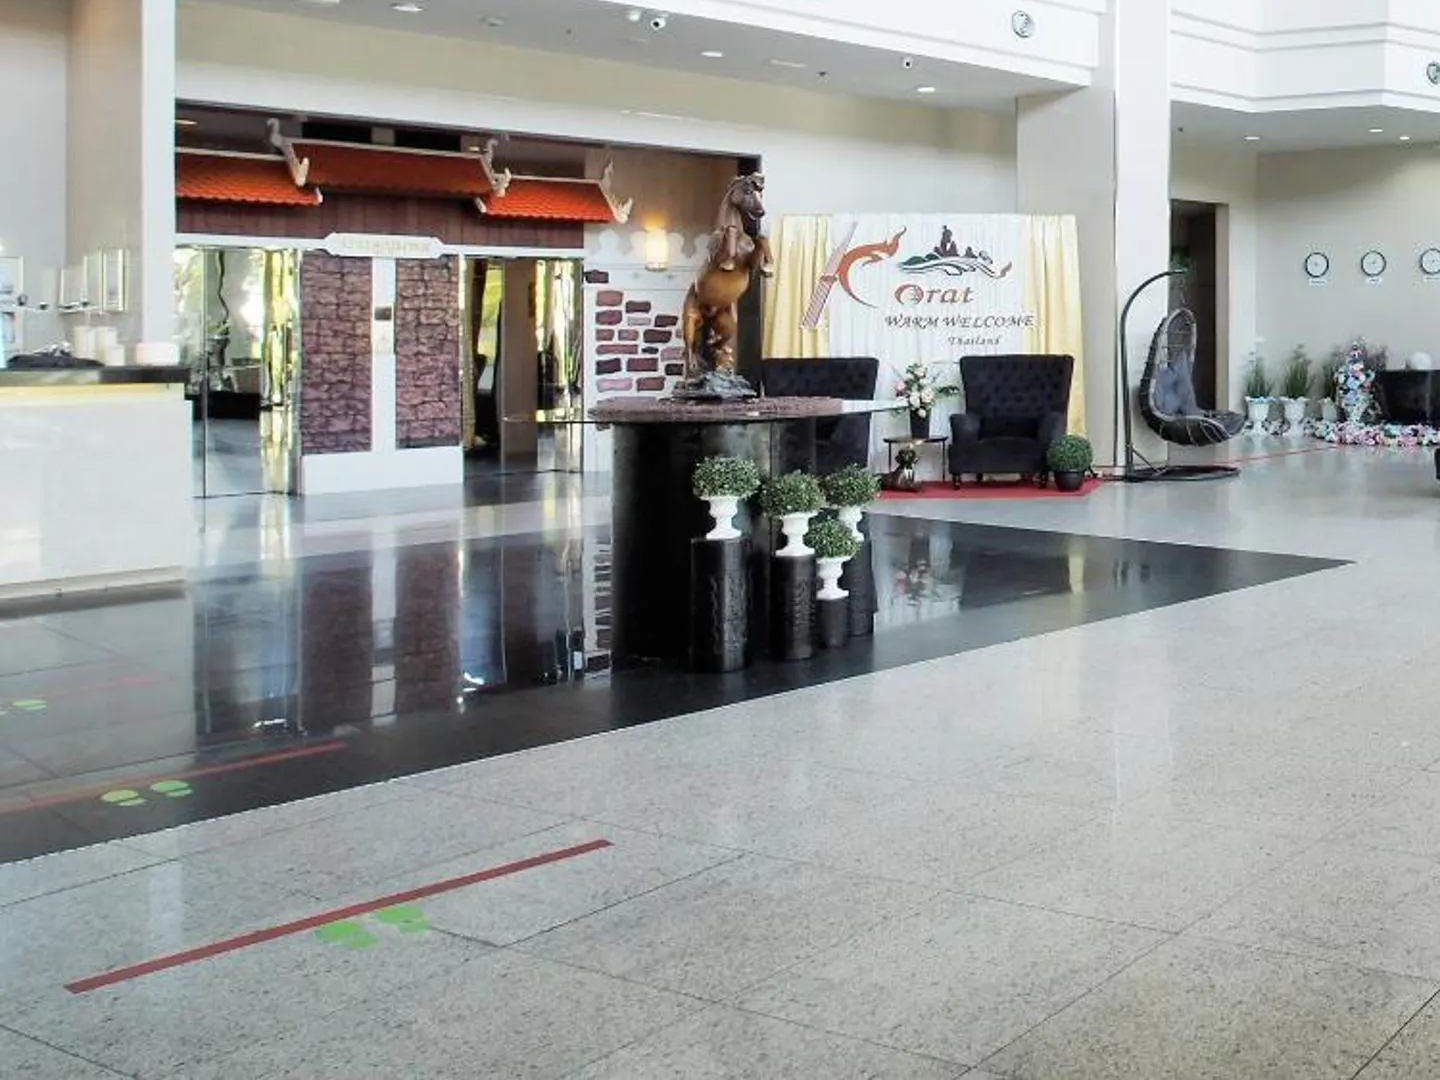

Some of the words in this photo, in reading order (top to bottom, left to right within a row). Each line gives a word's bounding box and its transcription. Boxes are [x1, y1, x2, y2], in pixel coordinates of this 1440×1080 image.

[885, 314, 938, 329] WARM
[943, 313, 1035, 328] WELCOME
[947, 335, 1001, 346] Thailand
